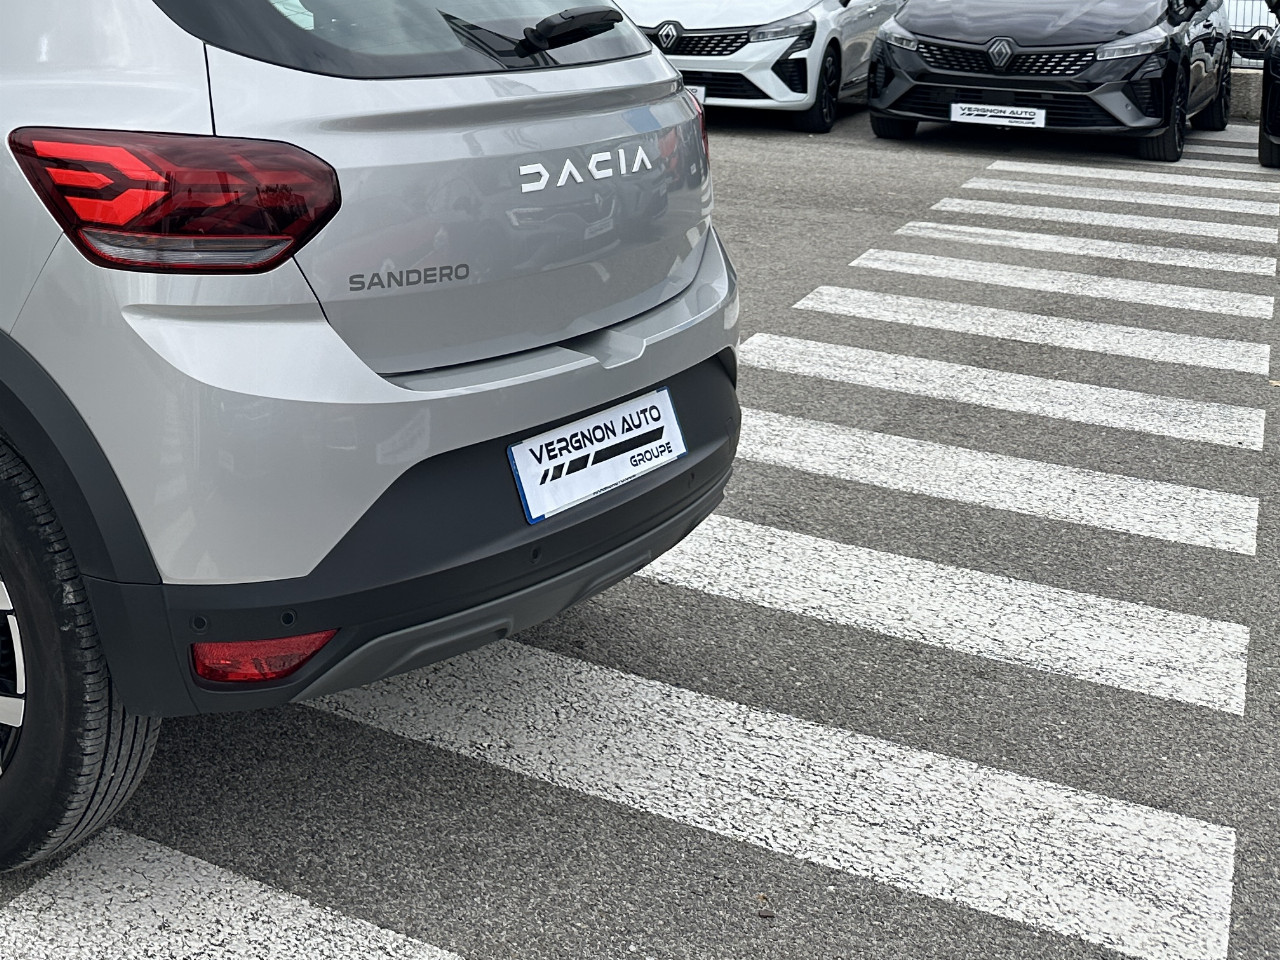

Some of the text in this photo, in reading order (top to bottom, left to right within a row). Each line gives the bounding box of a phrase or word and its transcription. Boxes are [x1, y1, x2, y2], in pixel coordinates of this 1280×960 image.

[960, 106, 1007, 115] VERGNON
[519, 145, 653, 193] DACIA
[348, 263, 470, 292] SANDERO
[529, 404, 662, 465] VERGNON AUTO
[629, 441, 673, 468] GROUPE
